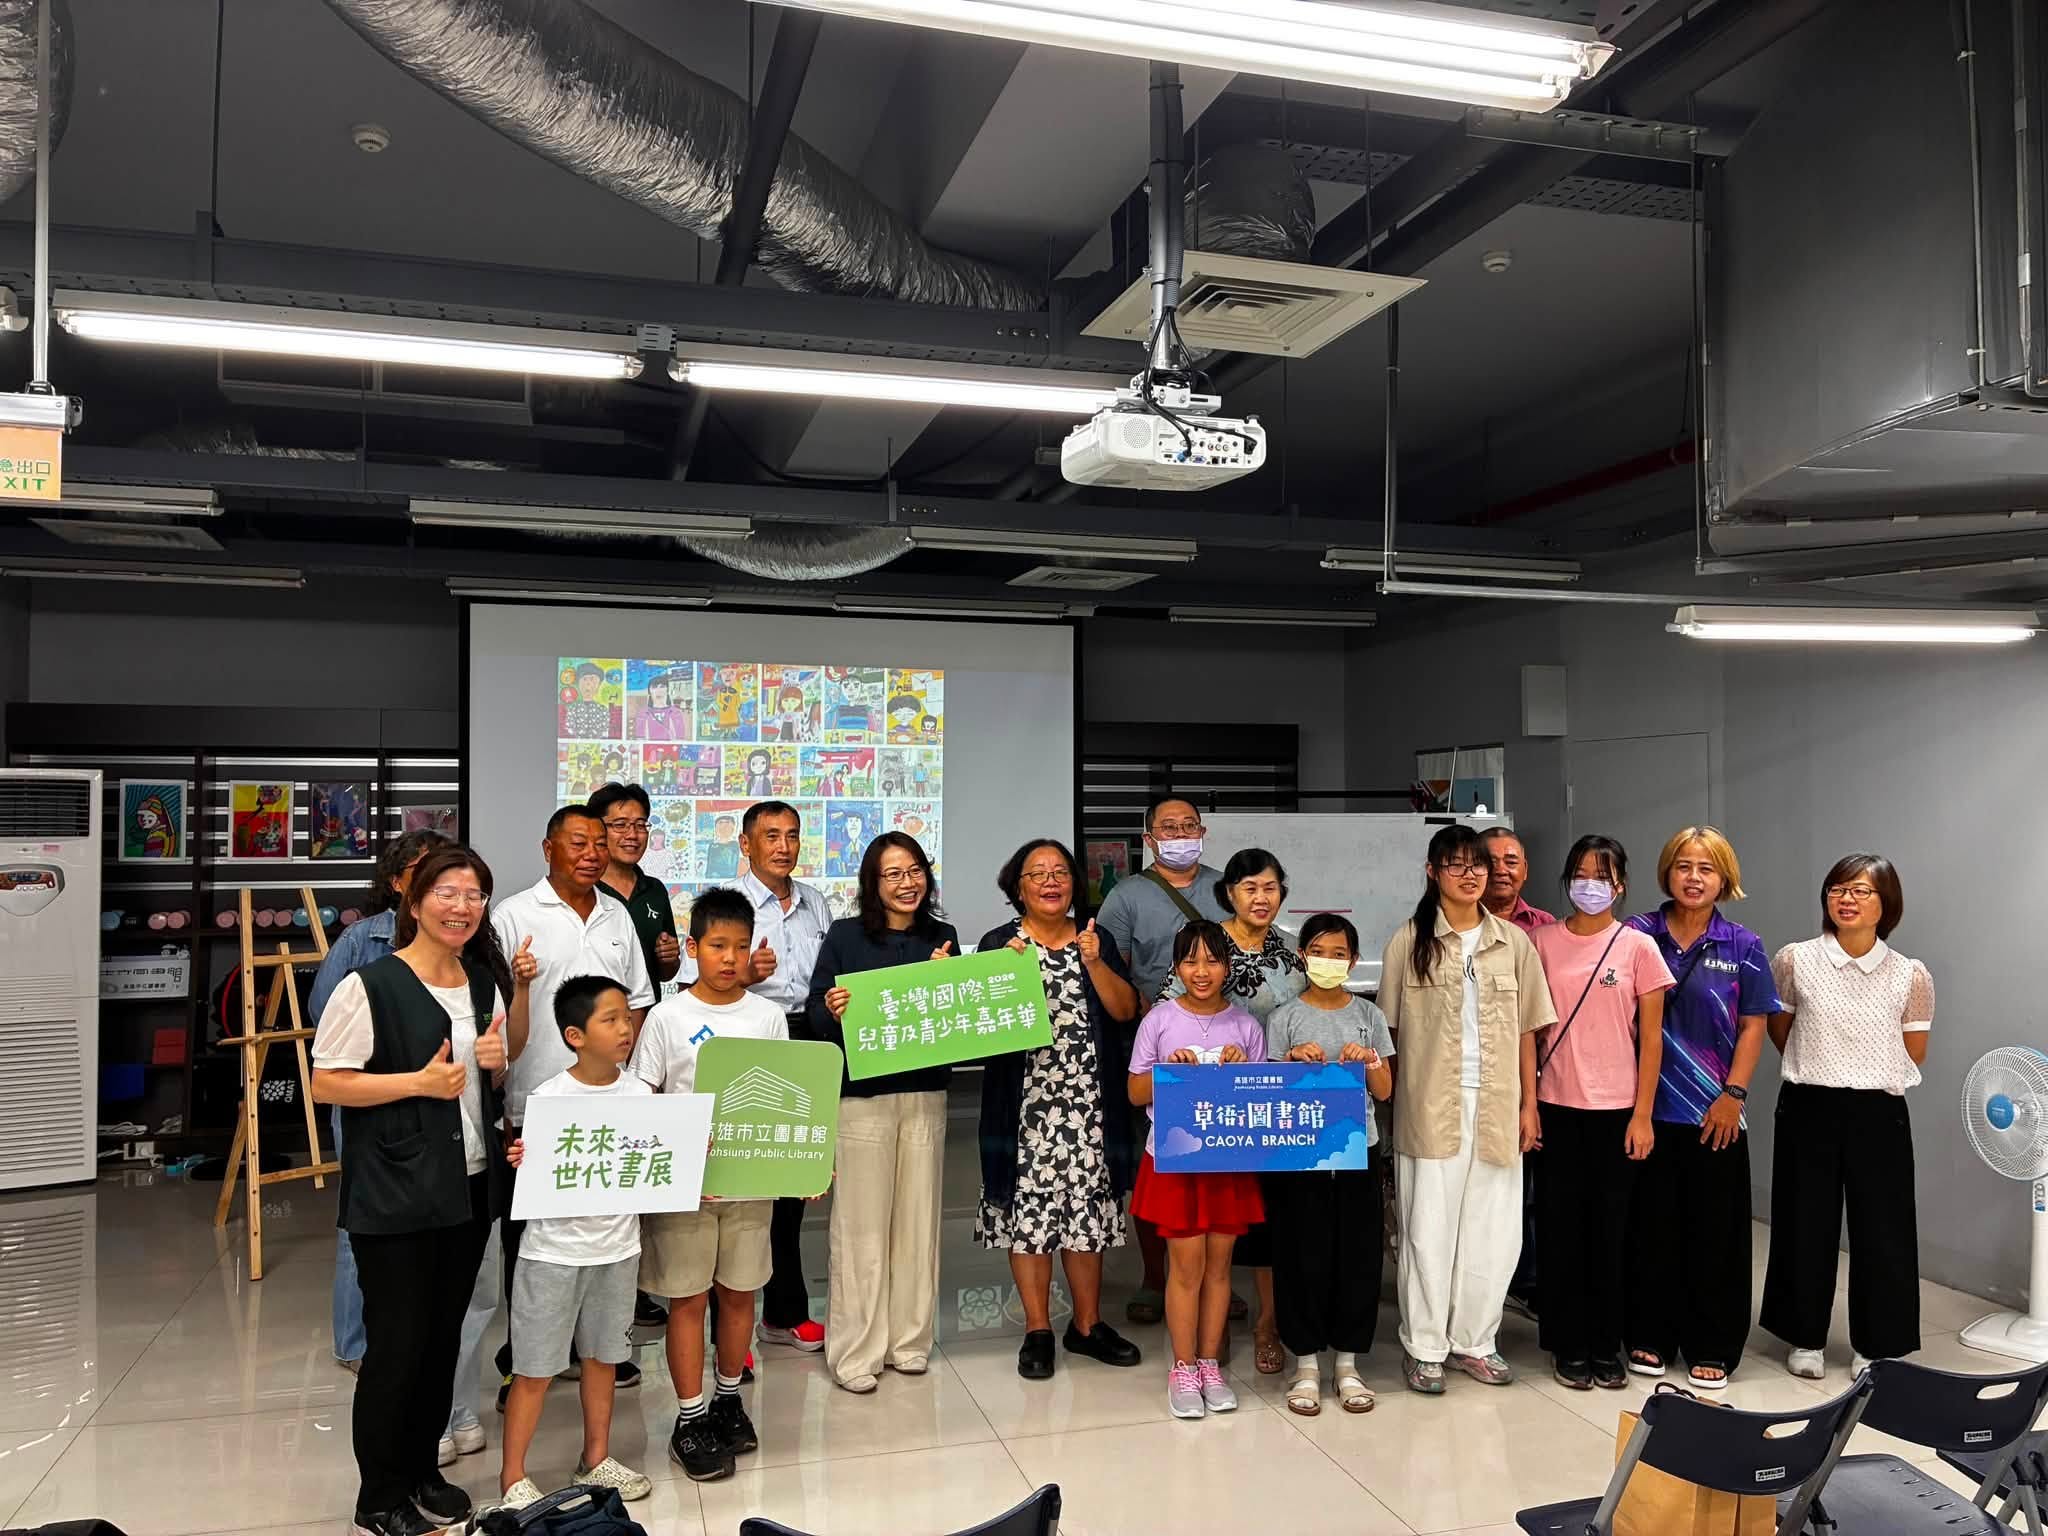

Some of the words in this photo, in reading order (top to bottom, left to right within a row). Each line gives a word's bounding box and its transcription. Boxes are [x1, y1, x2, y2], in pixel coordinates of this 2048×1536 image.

[987, 972, 1016, 984] 2026
[878, 979, 985, 1021] 臺灣國際
[858, 1001, 1037, 1052] 兒童及青少年嘉年華
[1193, 1101, 1326, 1130] 草衙圖書館
[554, 1123, 616, 1158] 未來
[754, 1147, 785, 1159] Public
[788, 1149, 825, 1161] Library
[1205, 1135, 1254, 1148] CAOYA
[1262, 1134, 1316, 1147] BRANCH
[552, 1150, 673, 1190] 世代書展
